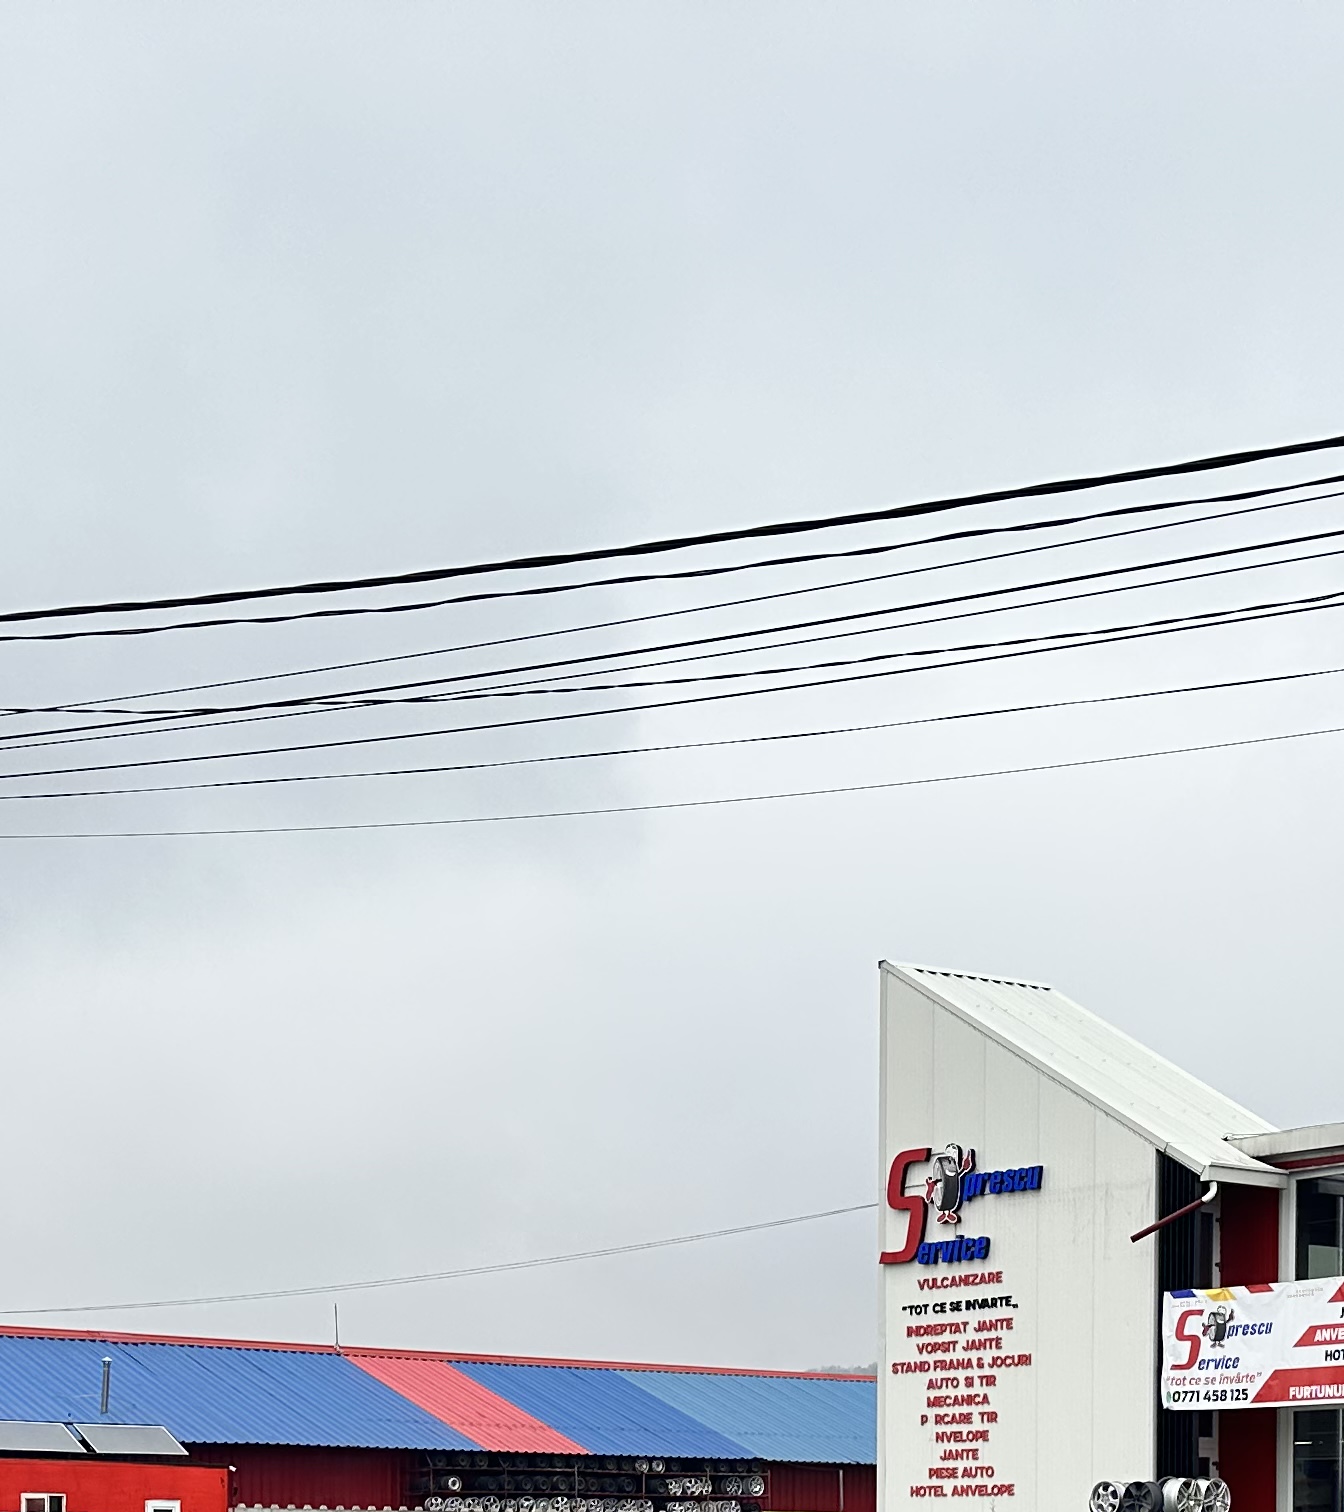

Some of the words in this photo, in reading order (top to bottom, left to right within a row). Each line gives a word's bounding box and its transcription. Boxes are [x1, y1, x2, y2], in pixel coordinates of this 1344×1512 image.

[918, 1271, 1003, 1291] VULCANIZARE
[932, 1303, 946, 1314] CE
[949, 1301, 962, 1312] SE
[907, 1321, 969, 1338] INDREPTAT
[974, 1318, 1014, 1333] JANTE
[916, 1340, 958, 1355] VOPSIT
[962, 1336, 1002, 1352] JANTE
[892, 1361, 931, 1374] STAND
[933, 1358, 974, 1372] FRANA
[976, 1357, 984, 1369] &
[988, 1353, 1032, 1369] JOCURI
[927, 1376, 959, 1390] AUTO
[964, 1375, 974, 1388] SI
[977, 1375, 997, 1387] TIR
[1189, 1376, 1201, 1386] ce
[1203, 1376, 1216, 1385] se
[926, 1393, 990, 1408] MECANICA
[1172, 1390, 1200, 1403] 0771
[1203, 1389, 1228, 1402] 458
[1230, 1388, 1248, 1401] 125
[979, 1411, 998, 1423] TIR
[940, 1448, 979, 1461] JANTE
[928, 1467, 959, 1479] PIESE
[961, 1466, 994, 1478] AUTO
[910, 1485, 947, 1497] HOTEL
[951, 1484, 1015, 1497] ANVELOPE
